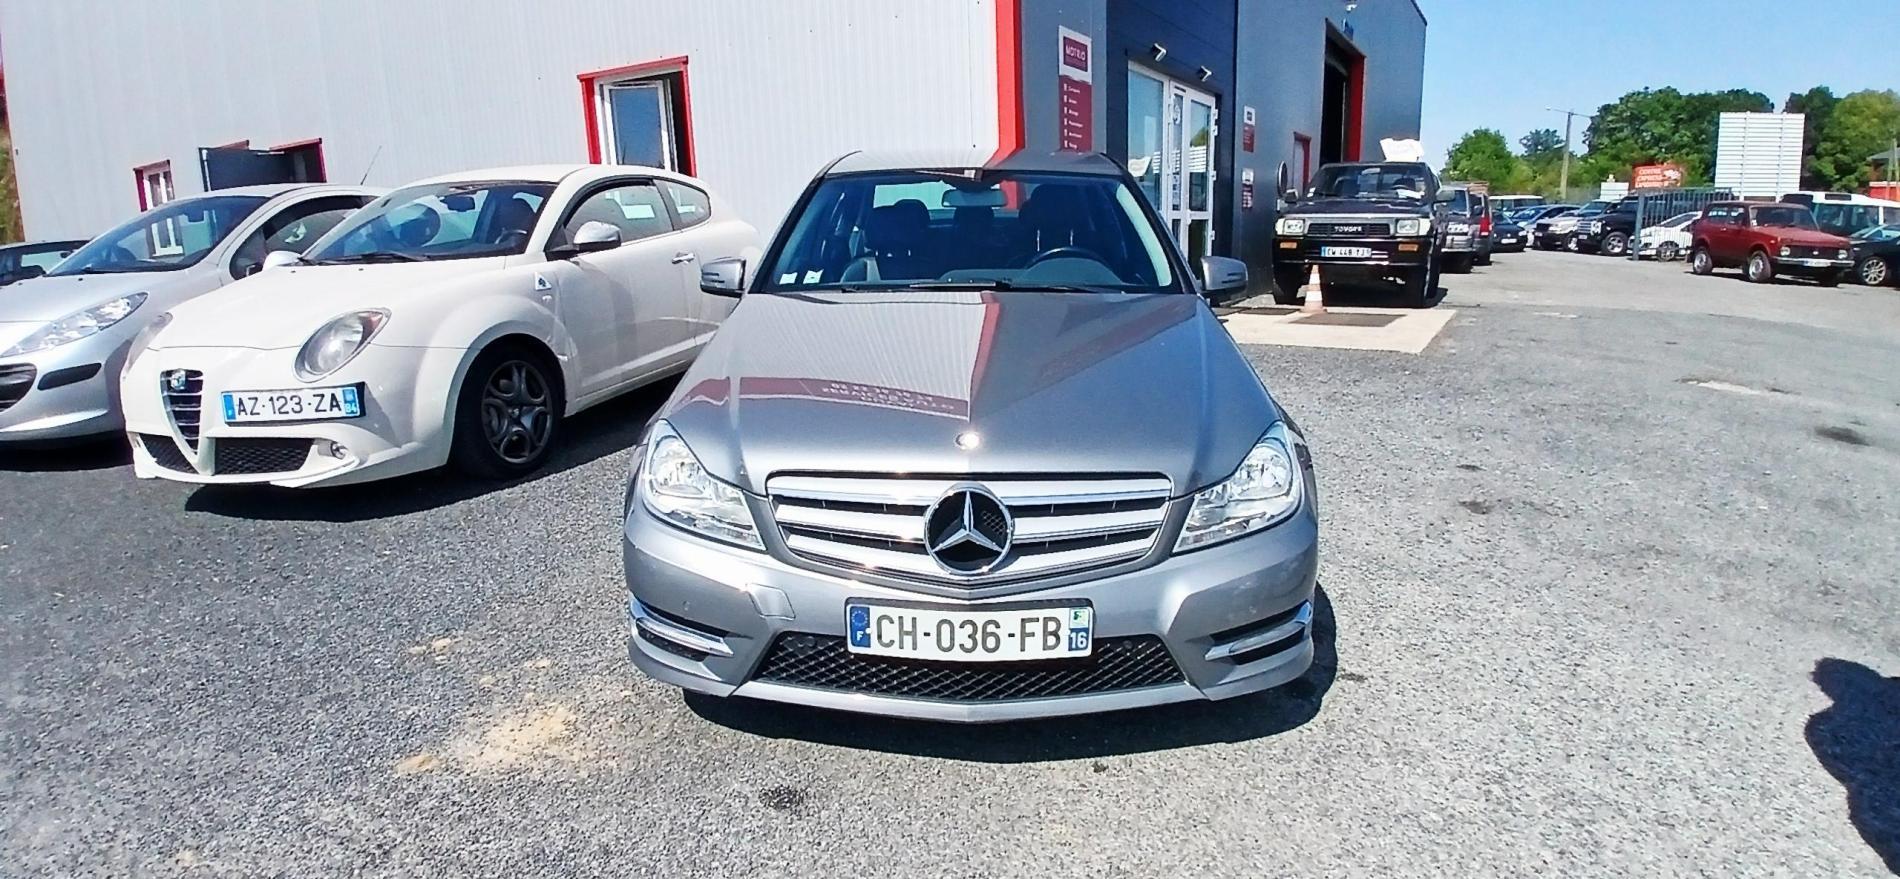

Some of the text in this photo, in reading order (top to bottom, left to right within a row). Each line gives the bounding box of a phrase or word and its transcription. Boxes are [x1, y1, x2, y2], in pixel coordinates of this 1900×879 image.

[237, 392, 342, 416] AZ-123-ZA
[856, 630, 864, 641] F
[876, 614, 1062, 654] CH-036-FB
[1070, 631, 1088, 650] 16
